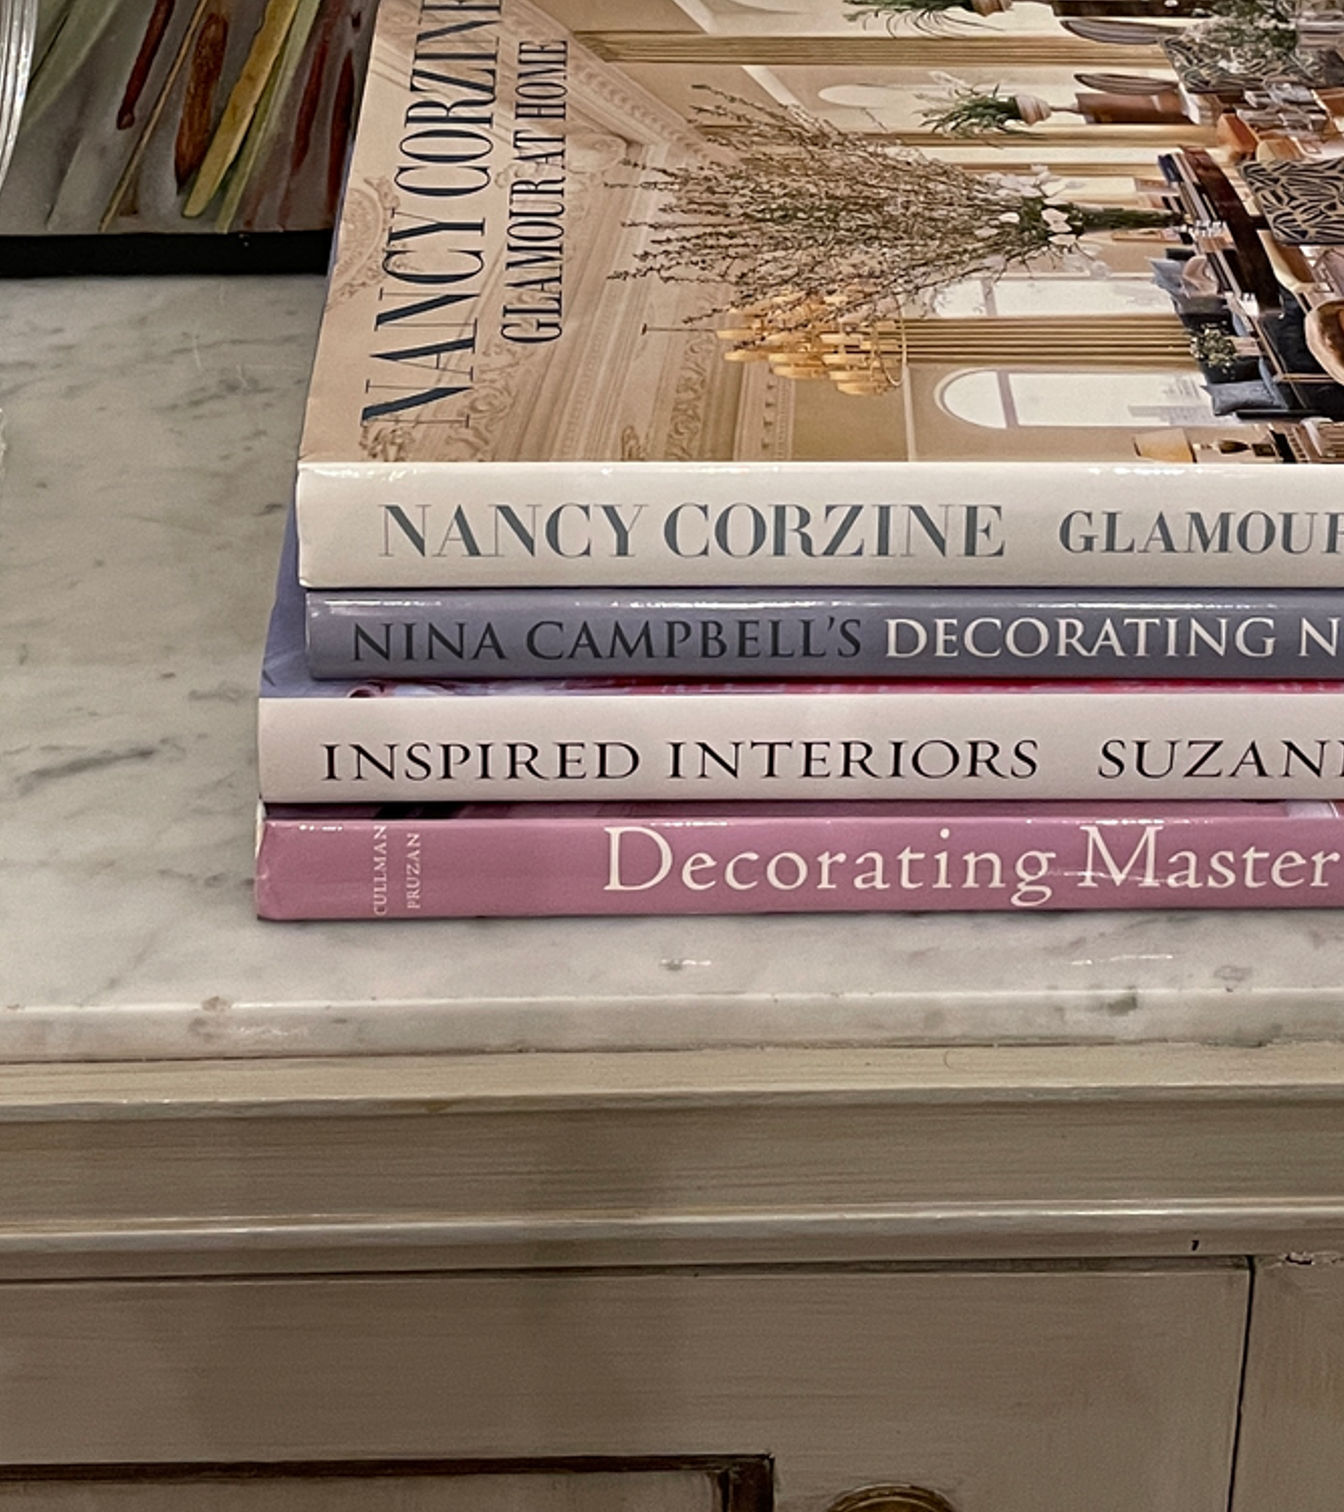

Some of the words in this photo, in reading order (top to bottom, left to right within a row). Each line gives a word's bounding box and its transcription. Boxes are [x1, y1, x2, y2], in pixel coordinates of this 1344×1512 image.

[514, 39, 569, 121] HOME
[513, 128, 567, 170] AT
[500, 178, 567, 344] GLAMOUR
[361, 207, 485, 428] NANCY
[378, 503, 649, 559] NANCY
[663, 502, 1005, 560] CORZINE
[350, 620, 508, 662] NINA
[525, 616, 863, 661] CAMPBELL'S
[884, 615, 1276, 660] DECORATING
[321, 740, 641, 783] INSPIRED
[667, 739, 1039, 781] INTERIORS
[373, 824, 388, 917] CULLMAN
[405, 831, 421, 909] PRUZAN
[603, 825, 1058, 909] Decorating
[1079, 823, 1340, 891] Master
